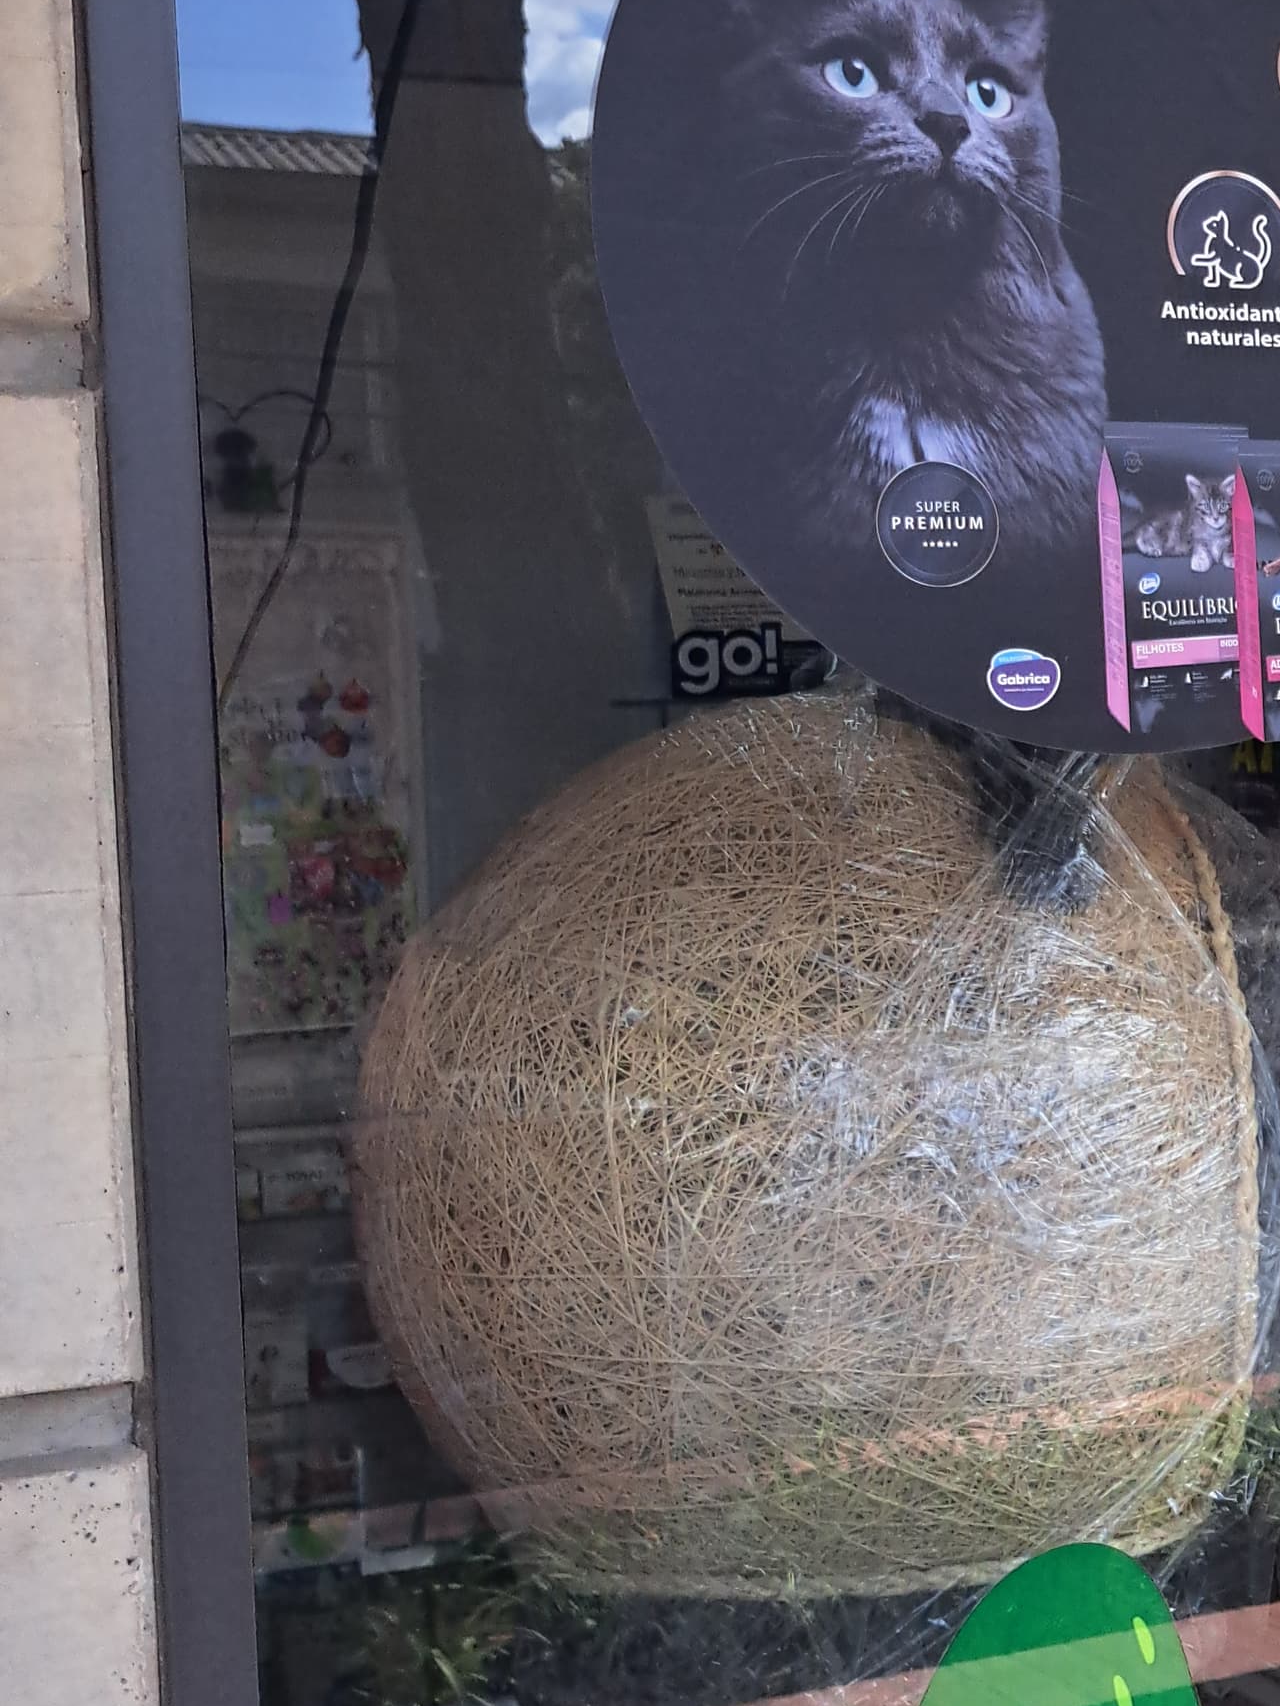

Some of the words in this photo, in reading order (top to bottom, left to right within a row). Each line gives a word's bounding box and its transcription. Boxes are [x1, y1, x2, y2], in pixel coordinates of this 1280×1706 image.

[915, 501, 960, 513] SUPER
[892, 516, 984, 530] PREMIUM
[1142, 595, 1238, 621] EQUILÍBRI
[1136, 642, 1185, 654] FILHOTES
[678, 629, 778, 695] go!
[997, 672, 1051, 686] Gabrica
